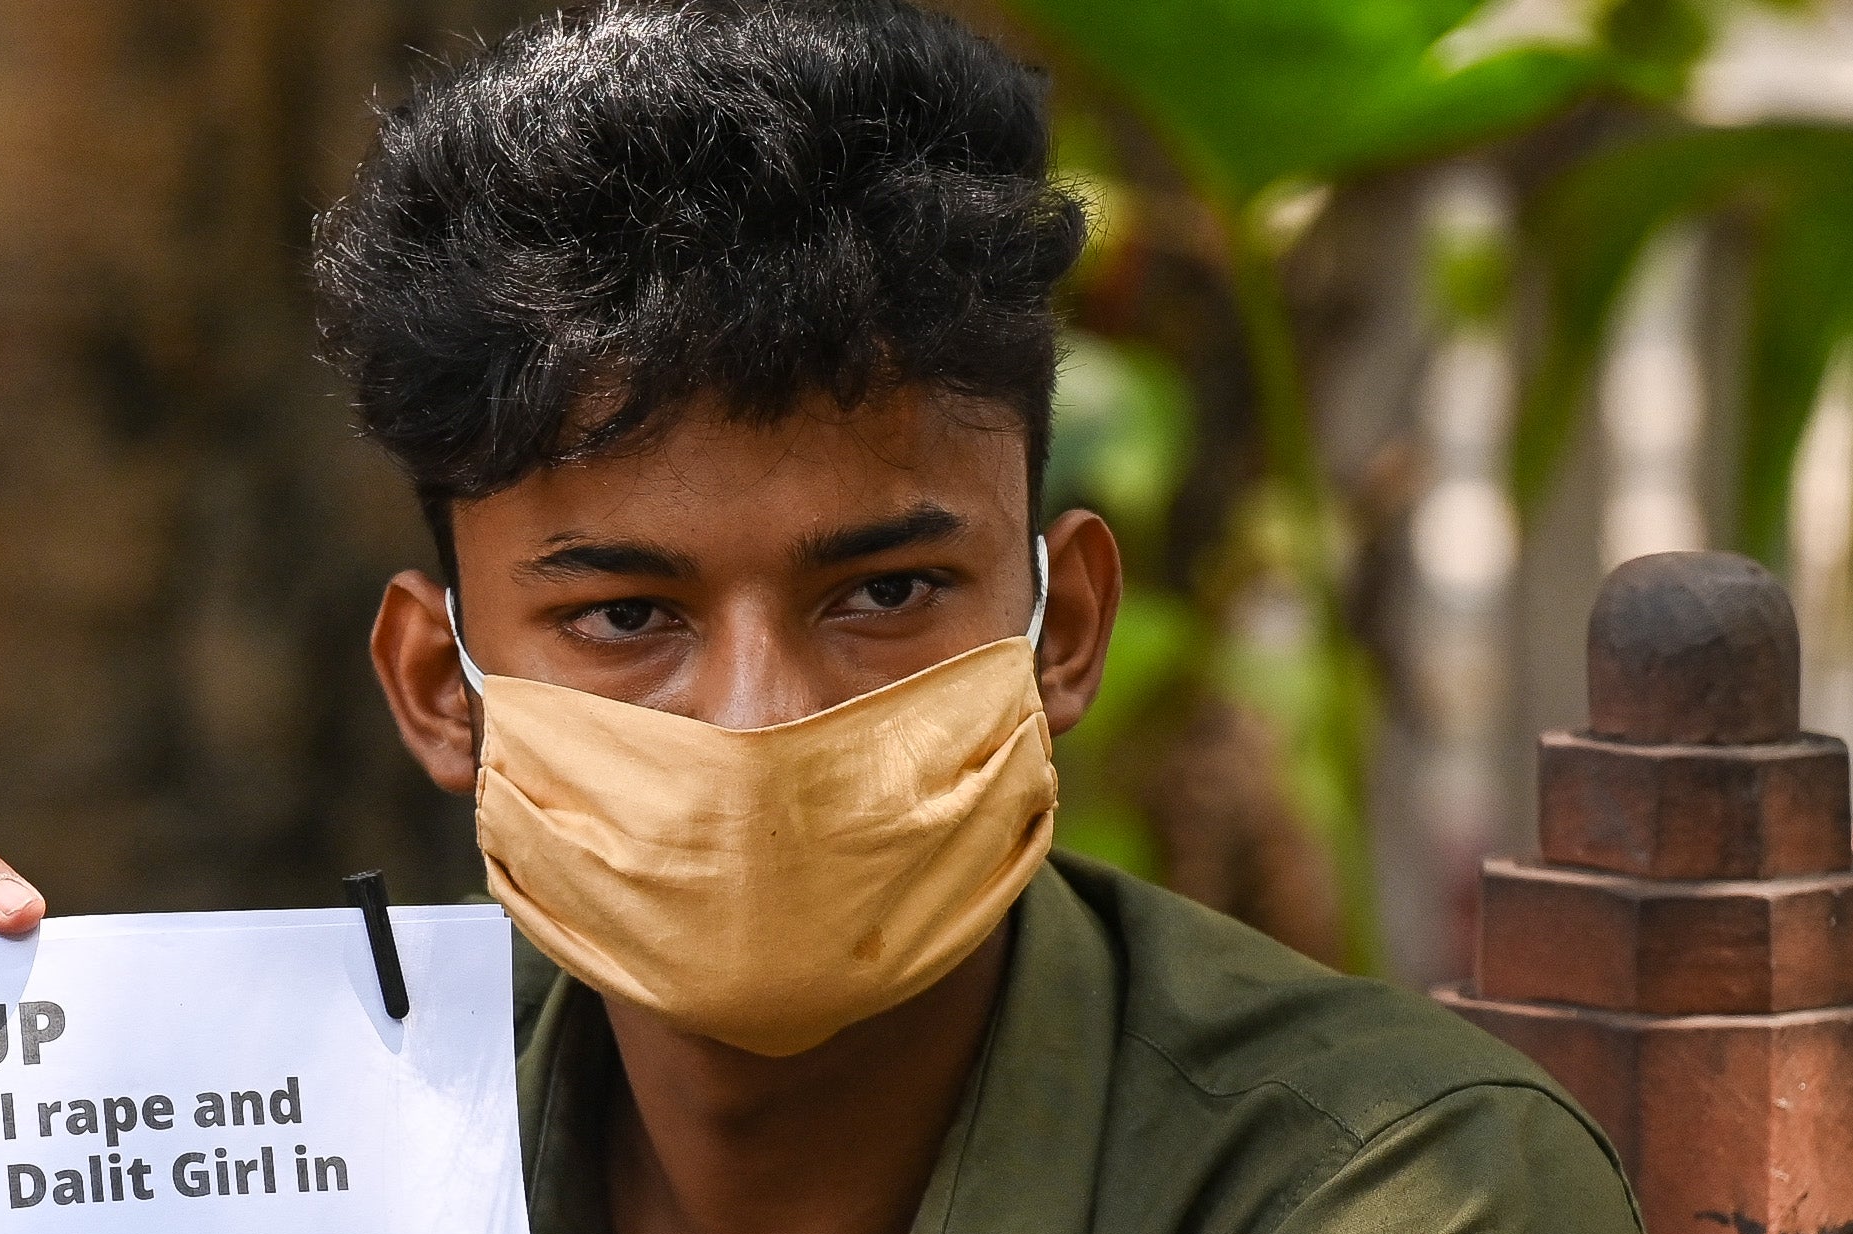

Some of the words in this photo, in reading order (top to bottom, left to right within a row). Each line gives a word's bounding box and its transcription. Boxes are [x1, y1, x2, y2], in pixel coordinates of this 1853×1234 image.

[38, 1095, 174, 1147] rape
[194, 1077, 301, 1128] and
[8, 1153, 154, 1209] Dalit
[173, 1147, 276, 1197] Girl
[295, 1145, 348, 1192] in
